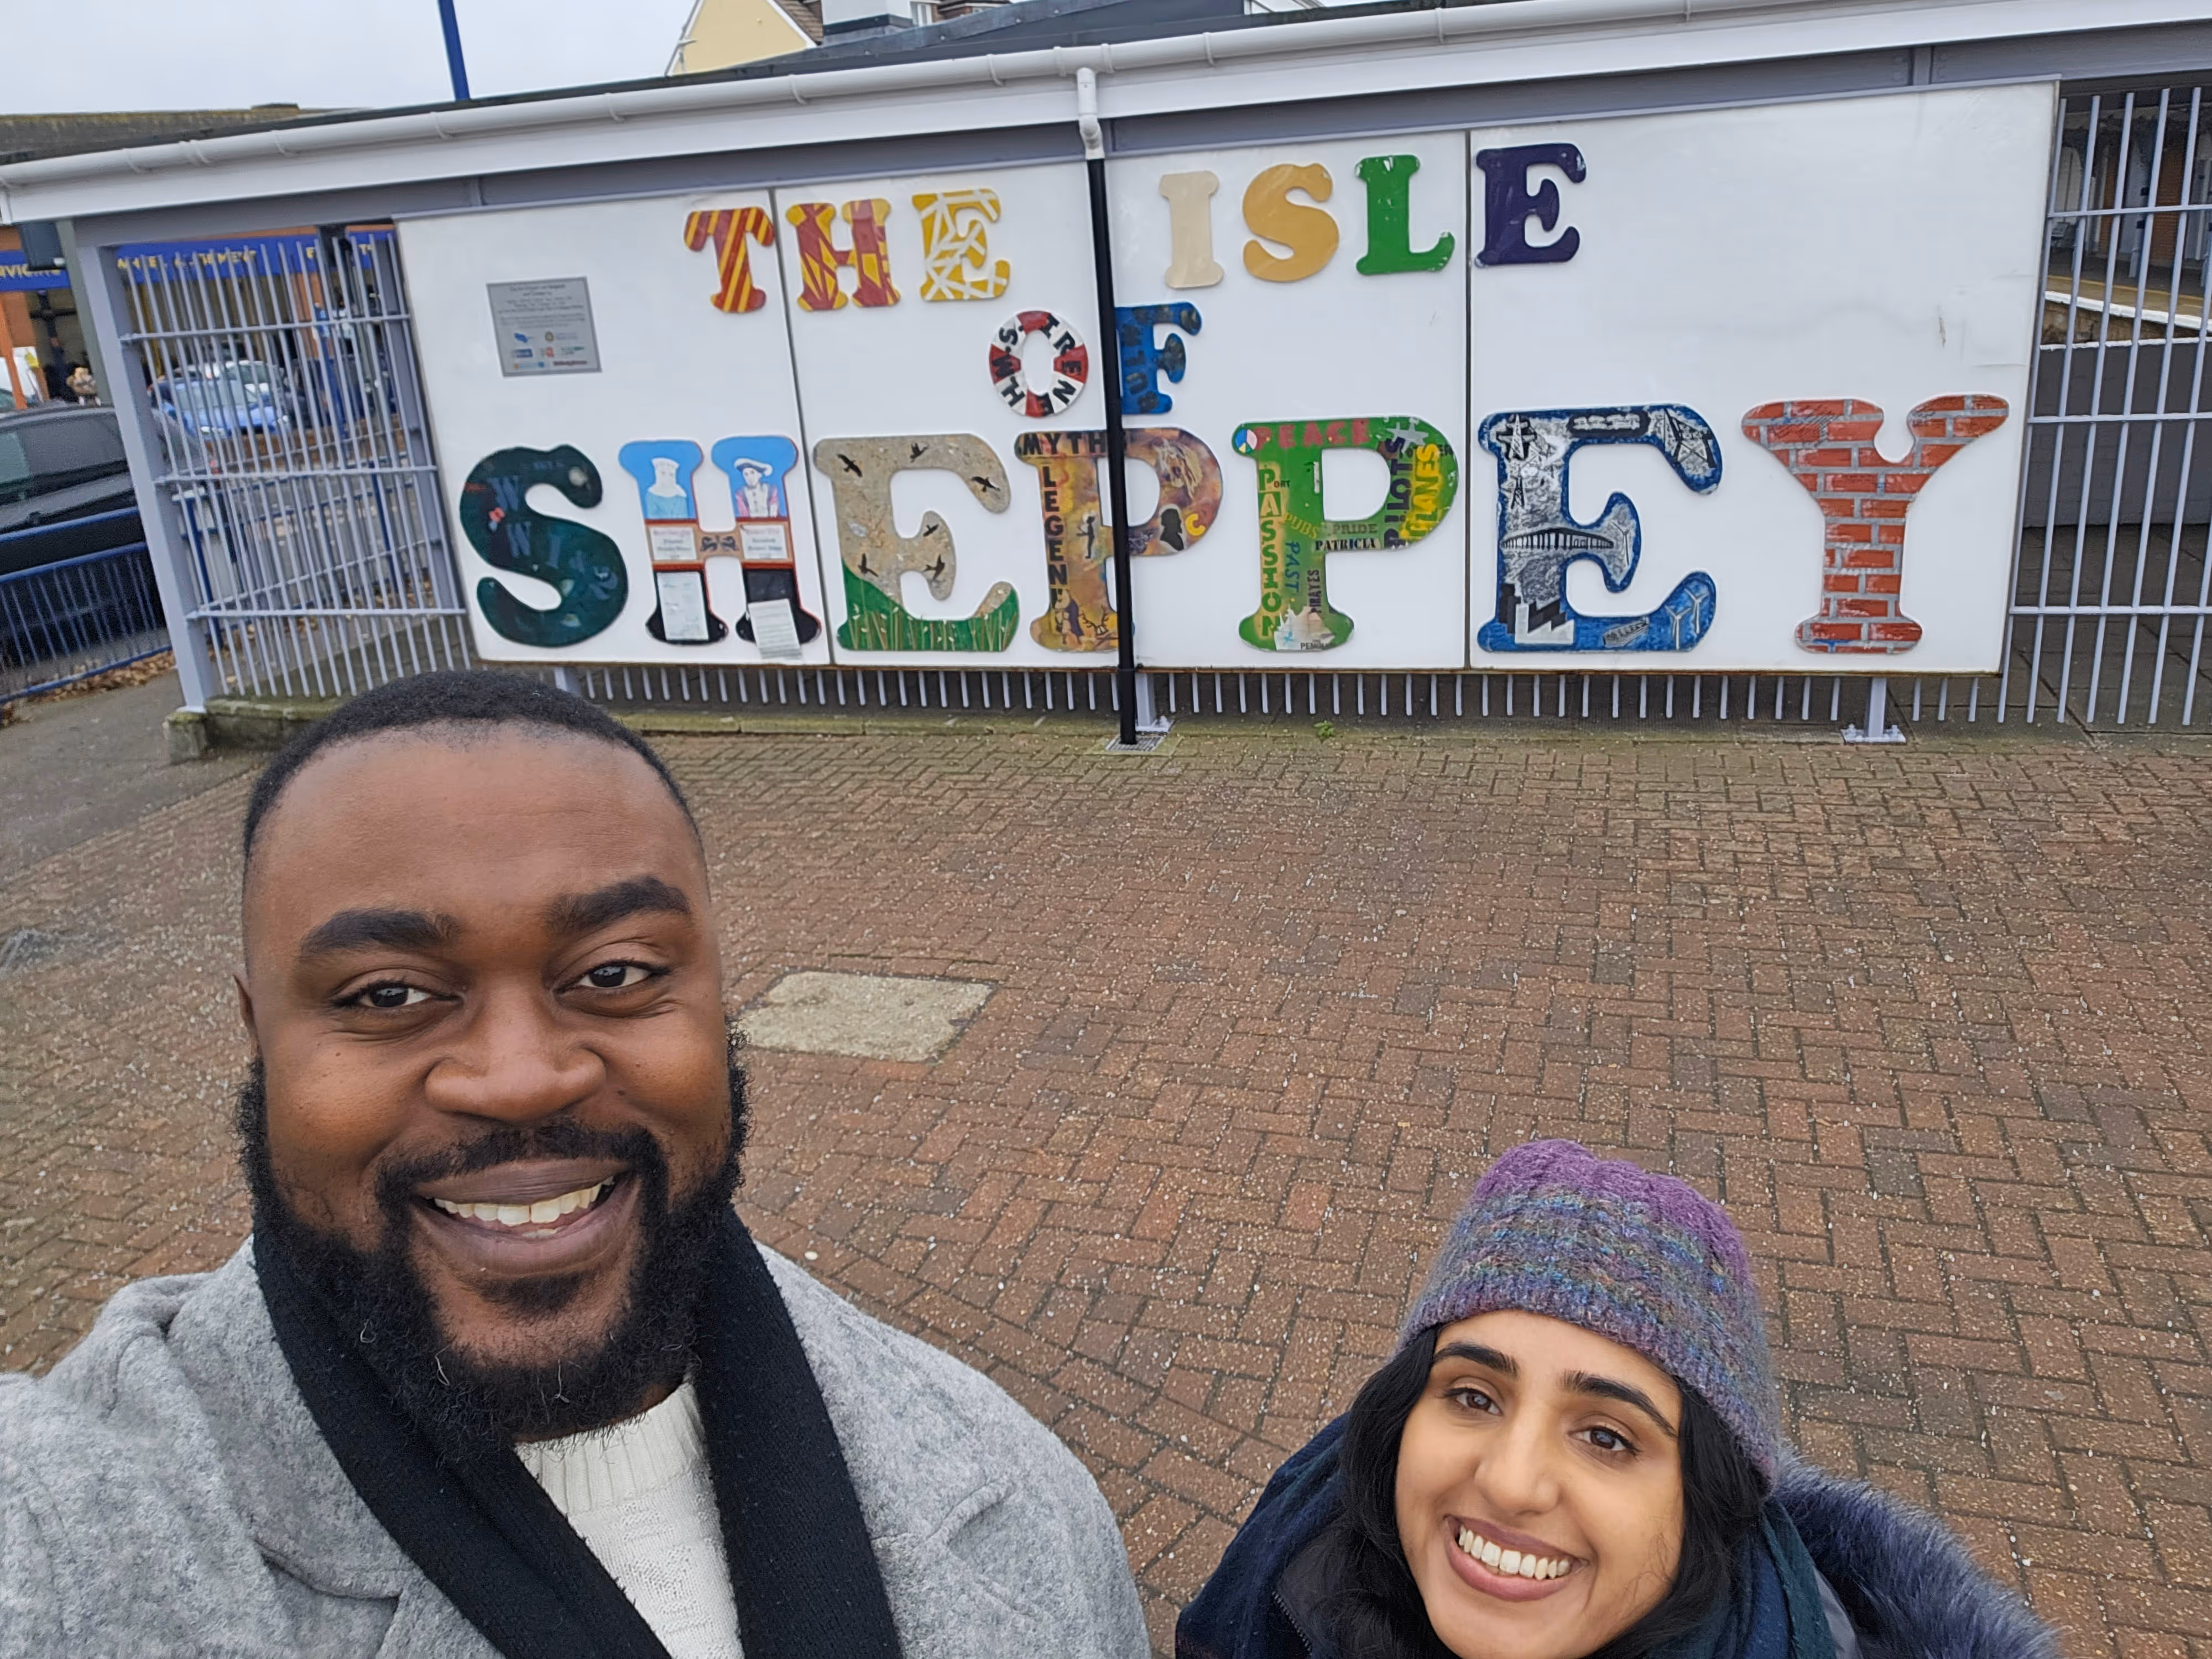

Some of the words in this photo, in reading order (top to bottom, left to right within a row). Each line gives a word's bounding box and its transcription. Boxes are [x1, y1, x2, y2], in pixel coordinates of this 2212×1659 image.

[684, 189, 1010, 312] THE
[1159, 143, 1587, 289] ISLE
[989, 301, 1202, 419] OF
[1253, 418, 1370, 450] PEACE
[460, 394, 2009, 654] SHEPPEY
[1284, 511, 1319, 539] PUBS
[1315, 538, 1379, 551] PATRICIA
[1332, 523, 1378, 535] PRIDE
[1258, 469, 1282, 637] PASSION
[1284, 541, 1301, 593] PAST
[1307, 569, 1322, 613] PIRATES
